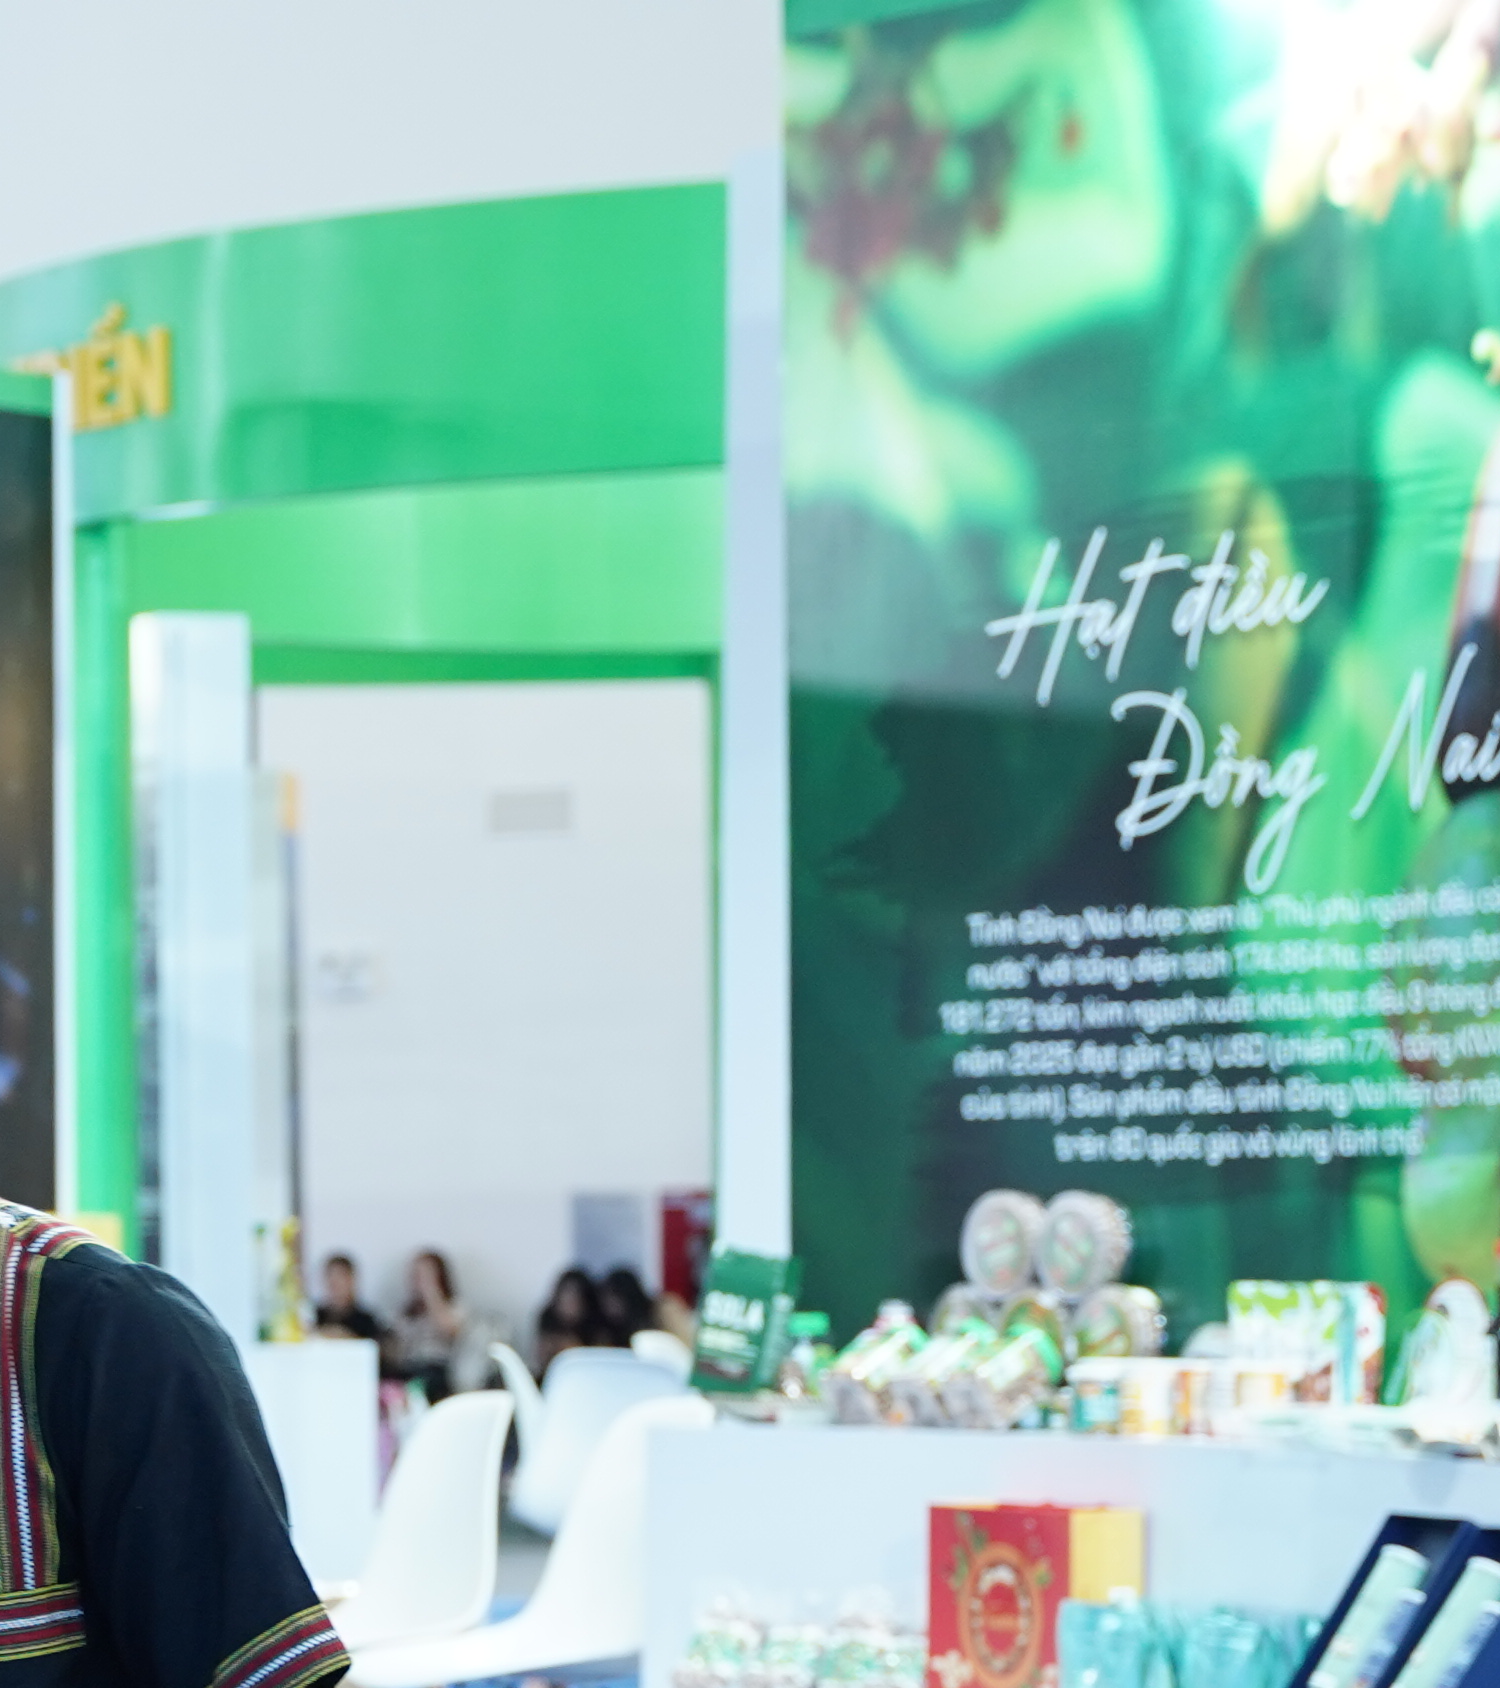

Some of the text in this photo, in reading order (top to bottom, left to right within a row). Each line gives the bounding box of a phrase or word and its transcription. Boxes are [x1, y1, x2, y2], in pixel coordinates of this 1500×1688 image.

[986, 526, 1330, 707] Hạt điều
[1111, 687, 1330, 895] Đồng
